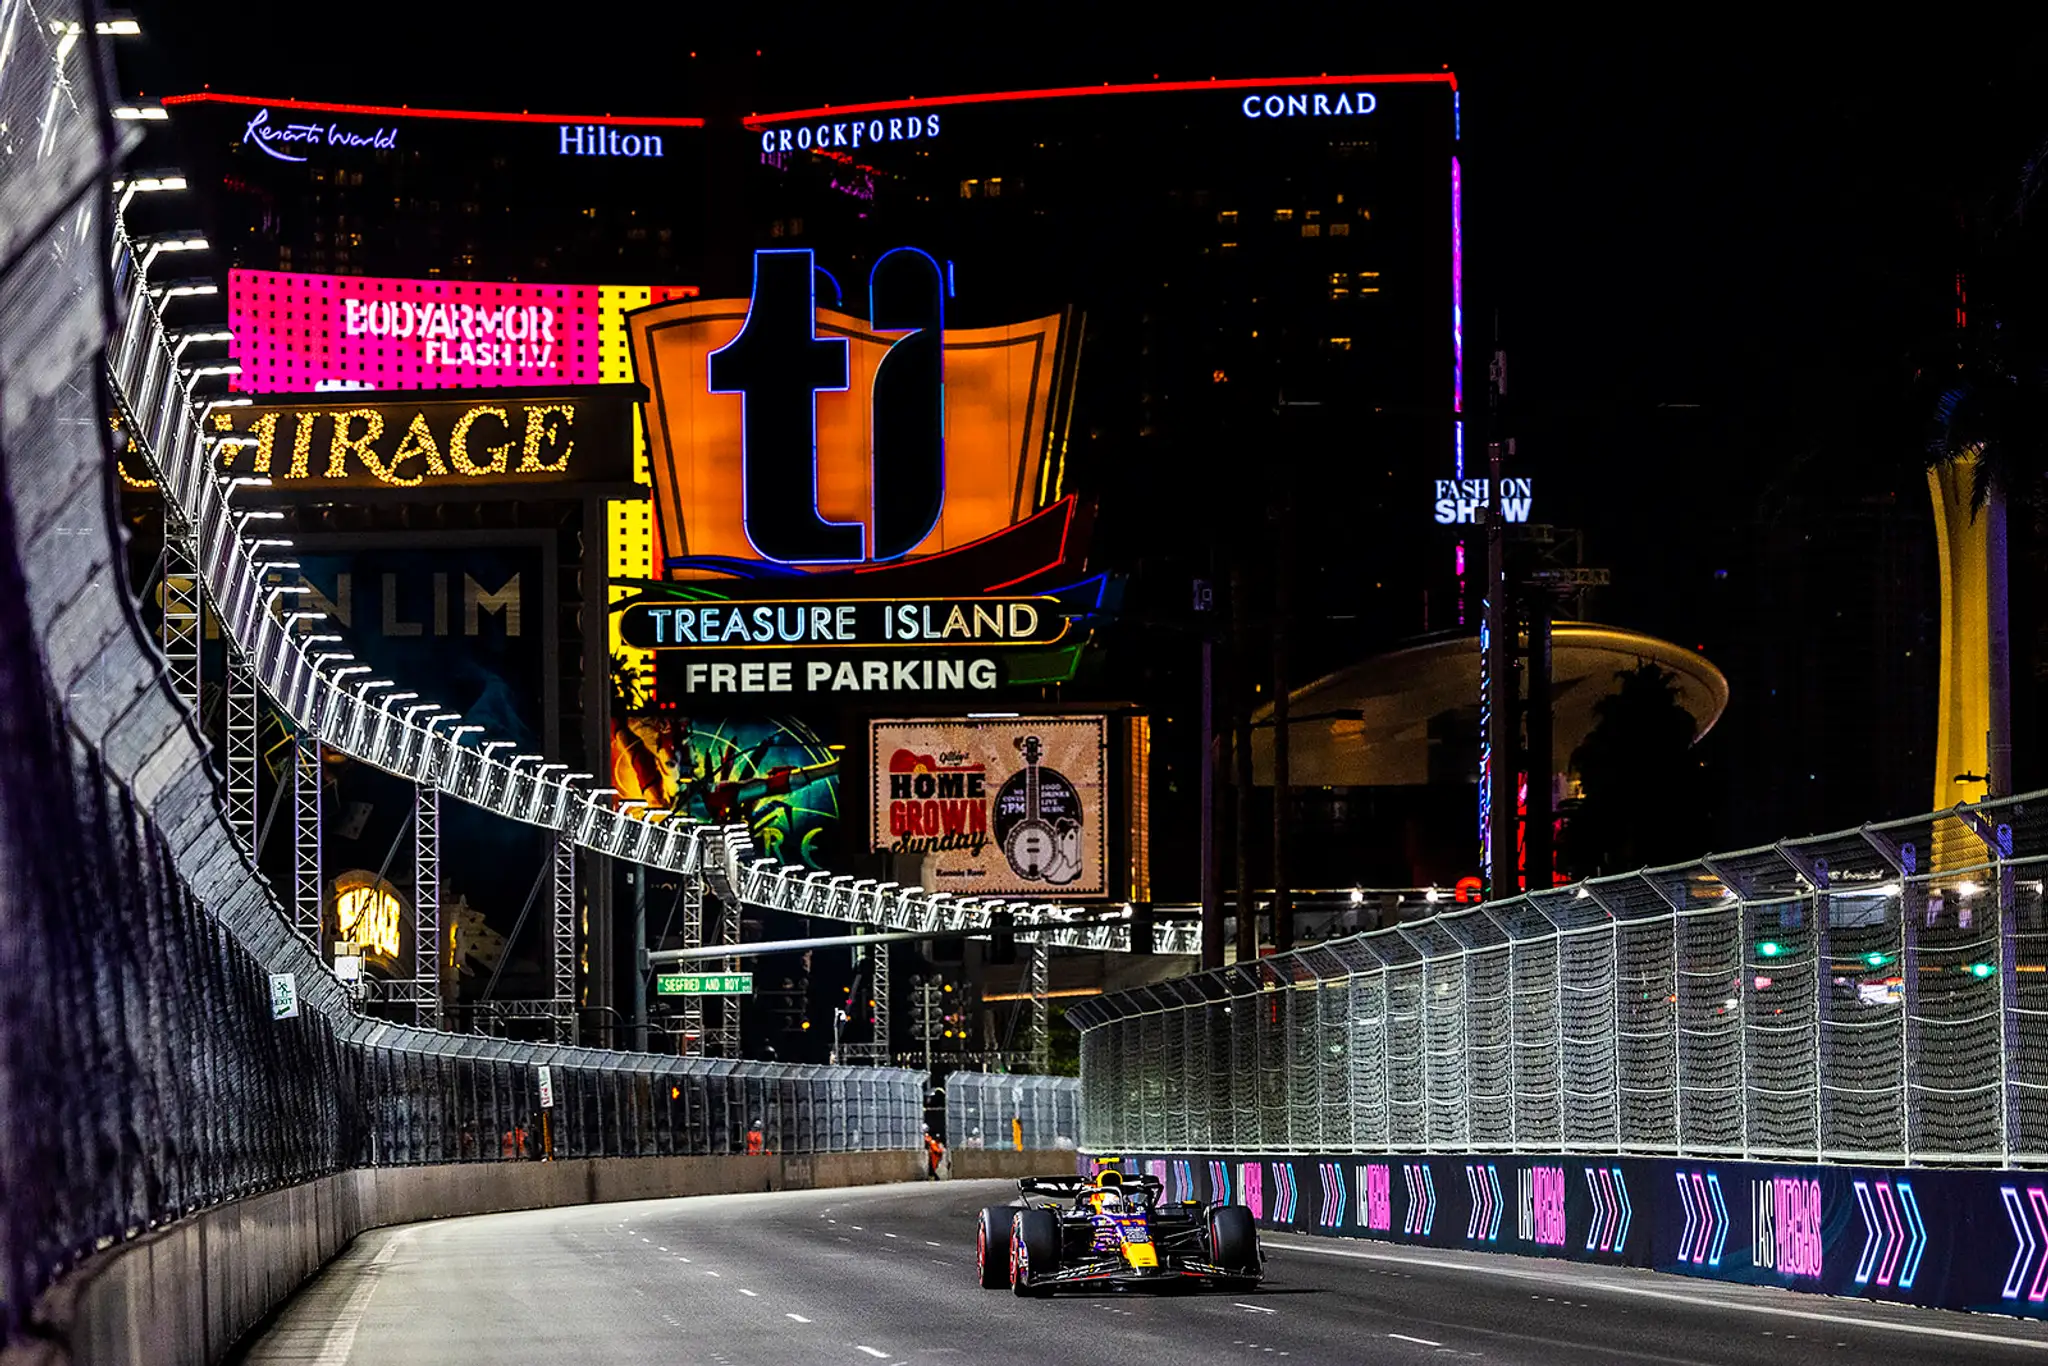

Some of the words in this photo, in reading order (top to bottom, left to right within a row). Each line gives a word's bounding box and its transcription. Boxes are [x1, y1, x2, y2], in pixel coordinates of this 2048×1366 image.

[1243, 92, 1377, 118] CONRAD
[243, 108, 323, 161] Resorts
[328, 124, 398, 150] World
[560, 125, 664, 158] Hilton
[762, 114, 941, 153] CROCKFORDS
[345, 298, 555, 342] BODYARMOR
[426, 340, 512, 367] FLASH
[519, 343, 557, 368] I.V.
[205, 404, 576, 486] MIRAGE
[1434, 478, 1532, 500] FASHON
[1434, 498, 1532, 524] SHW
[154, 574, 353, 640] SN
[382, 571, 521, 637] LIM
[648, 605, 857, 643] TREASURE
[885, 603, 1039, 639] ISLAND
[685, 663, 793, 693] FREE
[807, 659, 997, 691] PARKING
[890, 773, 986, 799] HOME
[890, 800, 987, 837] GROWN
[1001, 802, 1026, 816] 7PM
[893, 829, 992, 857] Sunday
[274, 997, 292, 1006] EXIT
[1517, 1168, 1534, 1241] LAS
[1533, 1166, 1566, 1246] VEGAS
[1751, 1179, 1774, 1268] LAS
[1773, 1176, 1823, 1277] VEGAS
